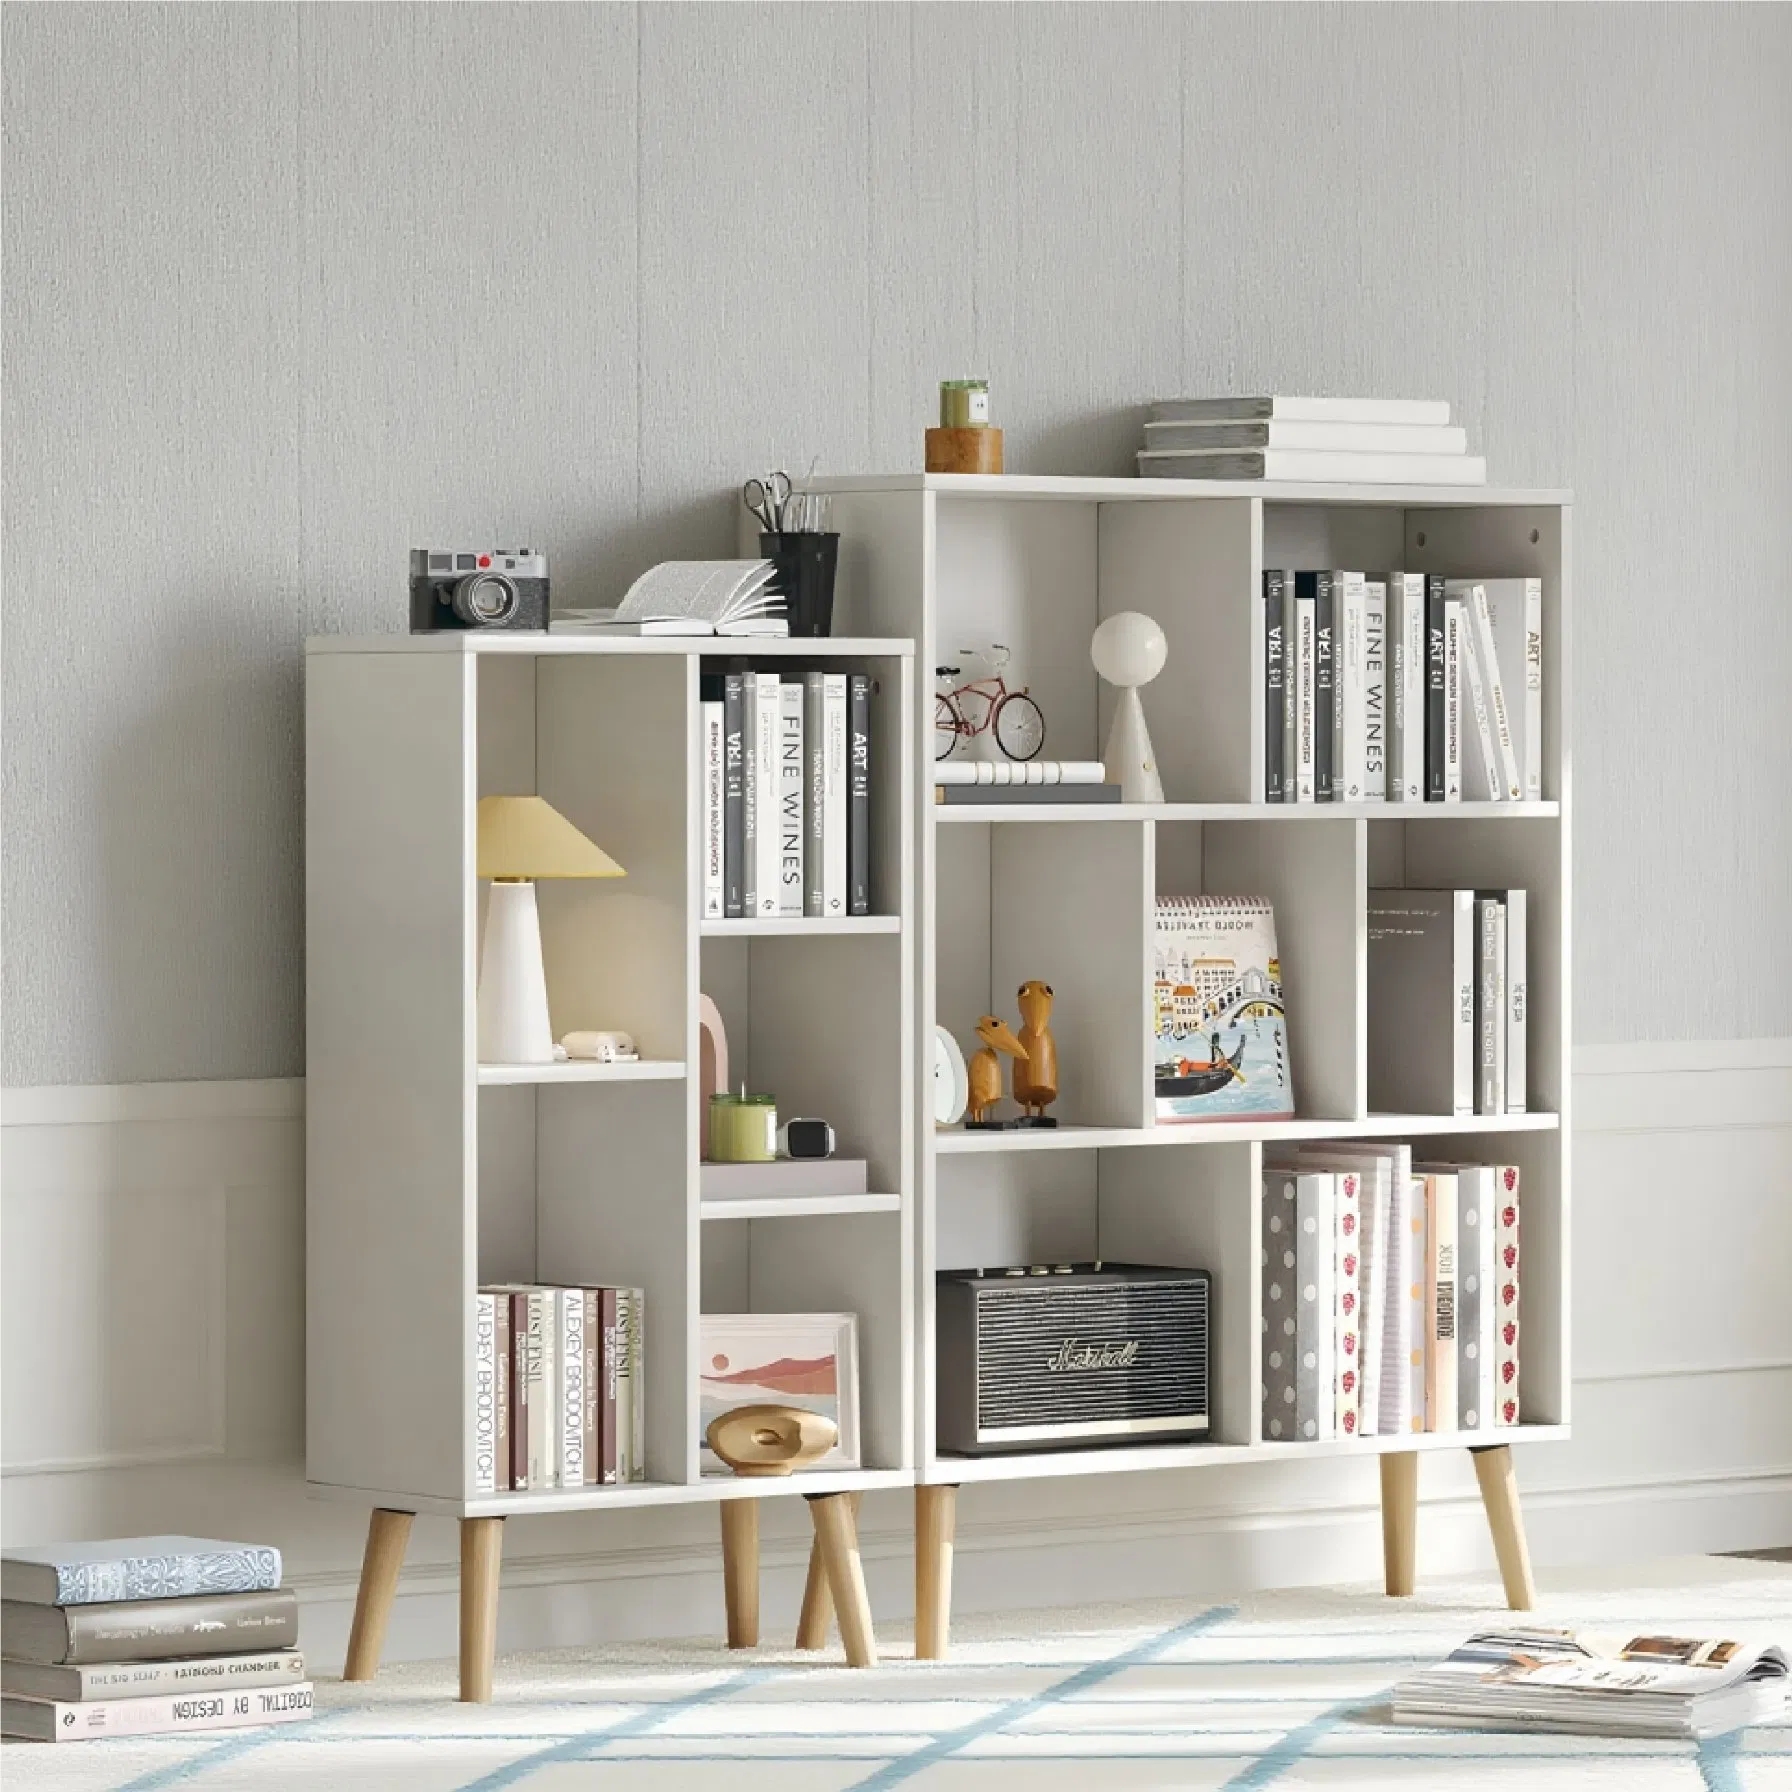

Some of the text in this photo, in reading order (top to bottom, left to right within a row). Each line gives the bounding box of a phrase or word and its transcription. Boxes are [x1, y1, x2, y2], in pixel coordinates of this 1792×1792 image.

[1431, 628, 1444, 664] ART
[1527, 631, 1540, 666] ART
[1366, 612, 1383, 774] FINE WINES
[782, 716, 800, 778] FINE
[853, 732, 867, 770] ART
[782, 791, 800, 885] WINES
[565, 1296, 582, 1476] ALEXEY BRODOVITCH
[228, 1661, 280, 1674] CHANDLER
[173, 1690, 312, 1721] DIGITAL BY DESIGN
